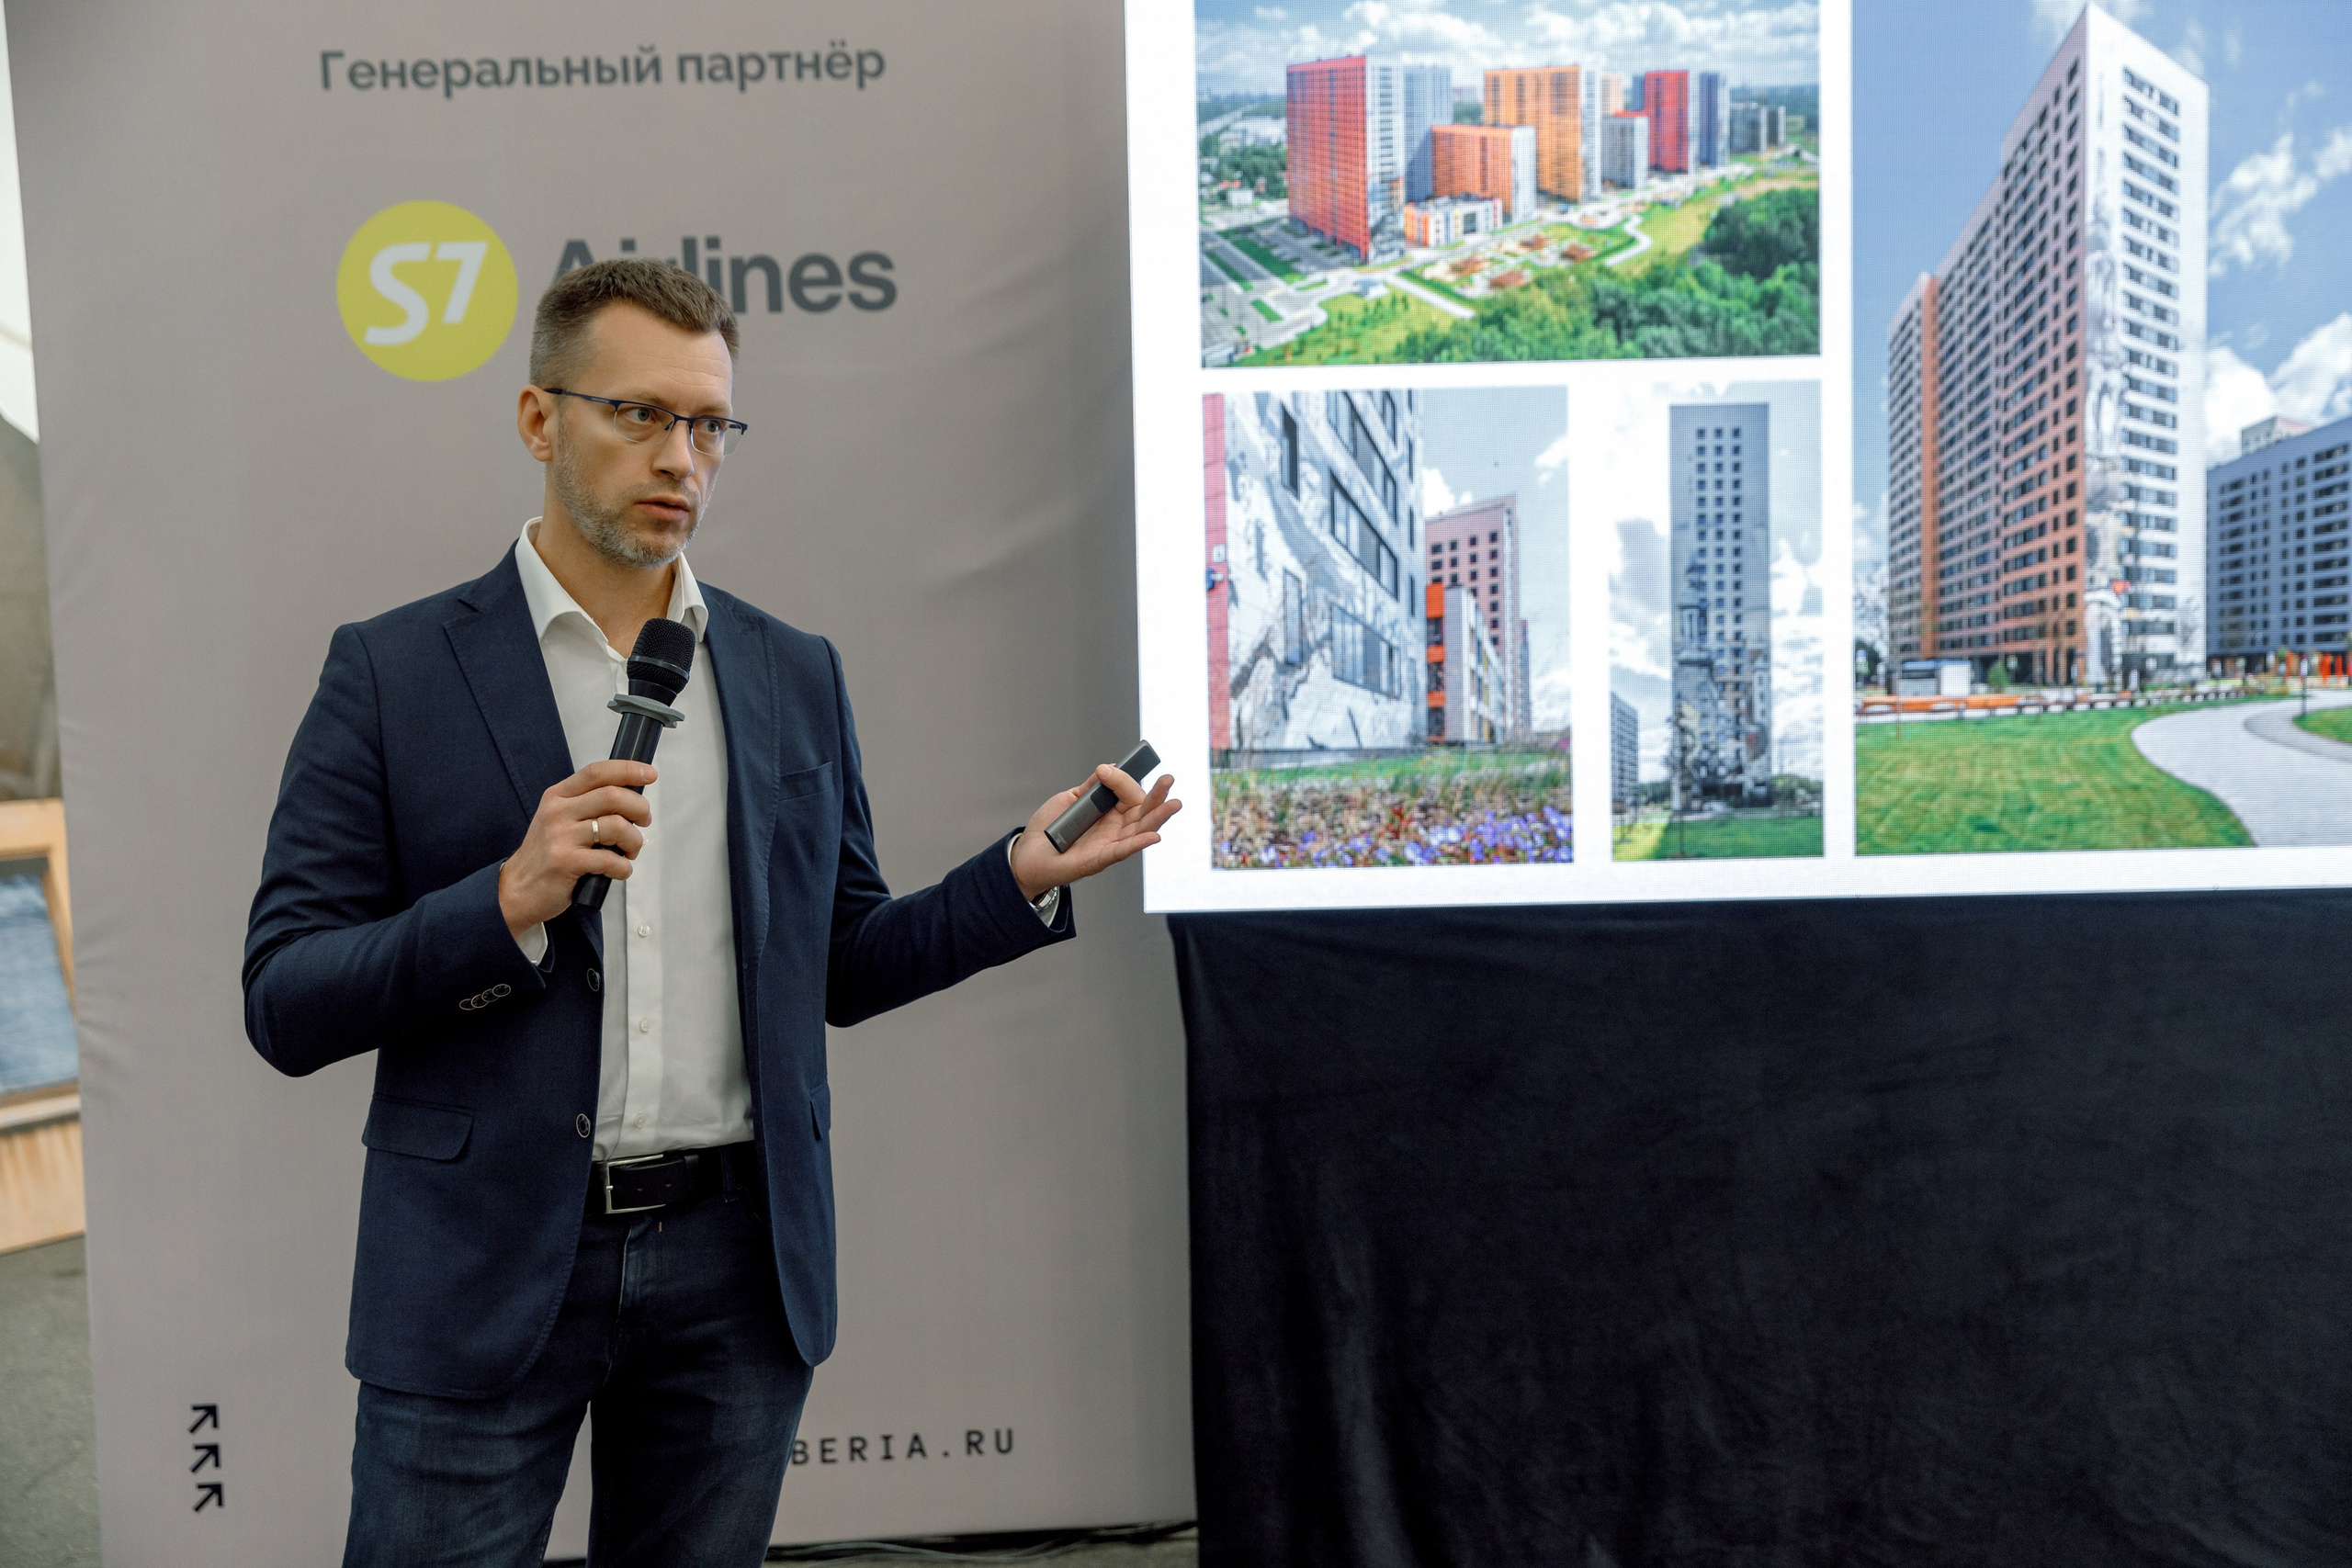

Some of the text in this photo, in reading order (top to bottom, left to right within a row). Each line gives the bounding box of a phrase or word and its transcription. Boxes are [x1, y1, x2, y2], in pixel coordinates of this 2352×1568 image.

[321, 39, 887, 98] Генеральный партнёр
[363, 235, 899, 346] S7 Alines
